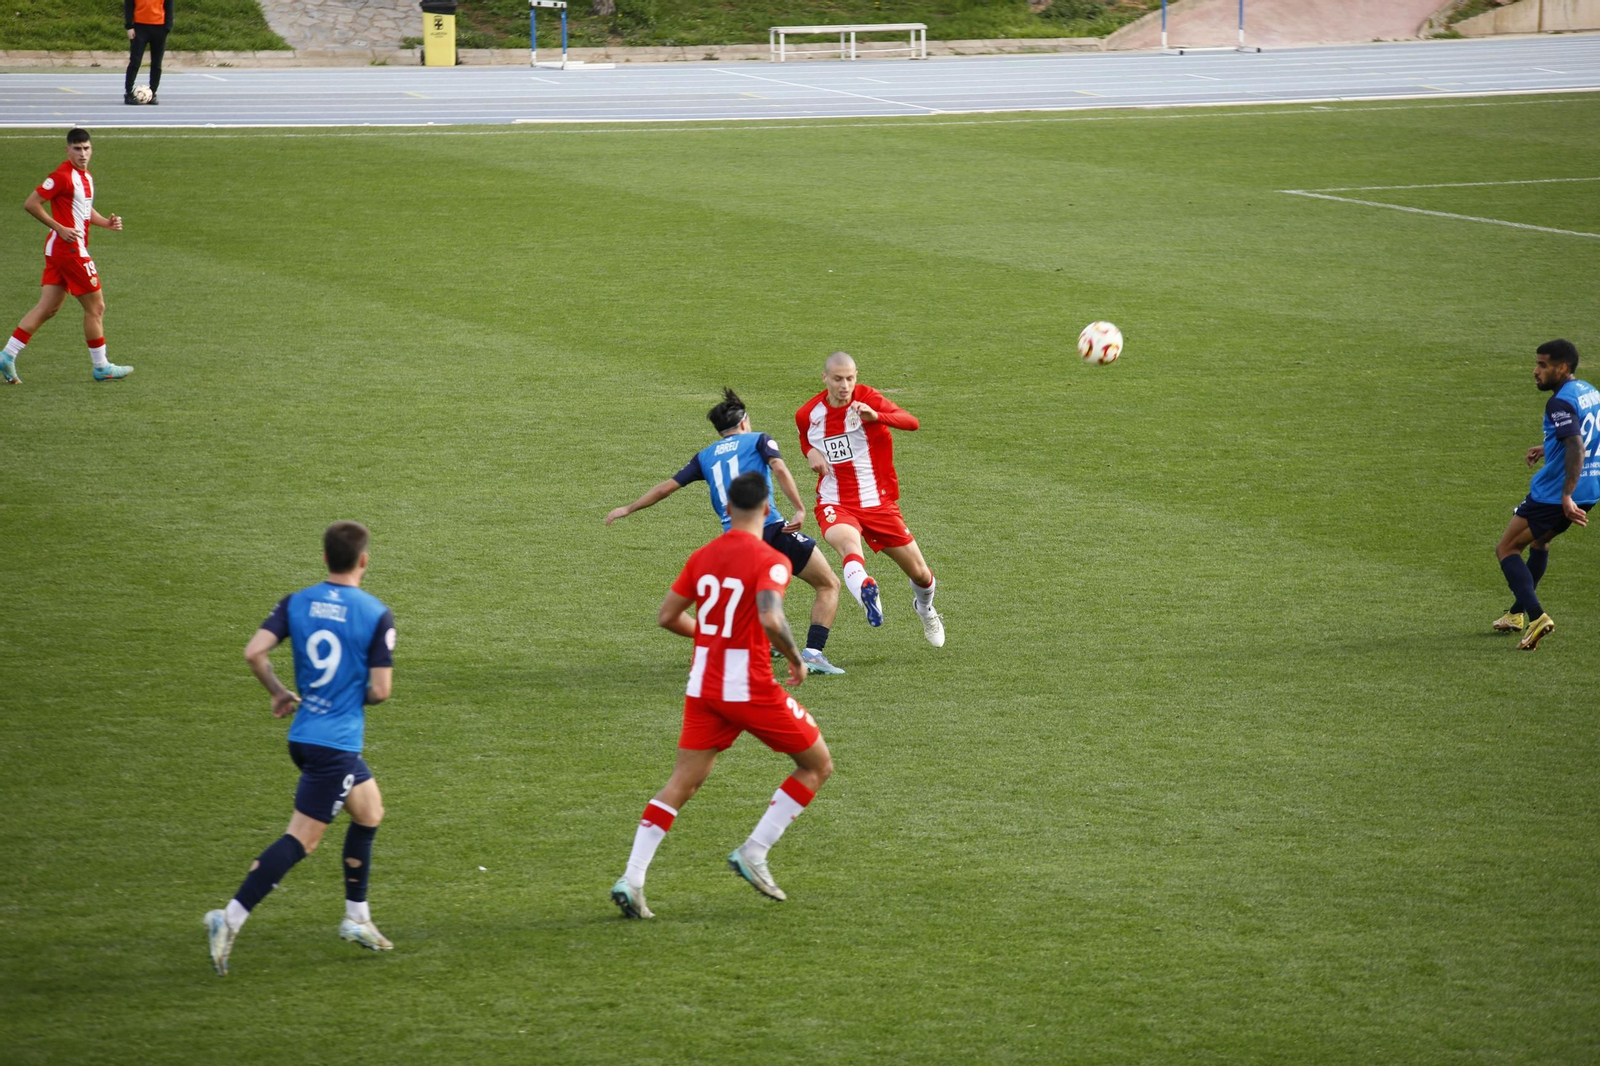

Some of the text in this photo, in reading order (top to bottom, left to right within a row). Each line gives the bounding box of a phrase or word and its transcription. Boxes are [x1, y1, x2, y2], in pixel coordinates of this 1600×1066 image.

[83, 260, 98, 277] 19
[714, 440, 739, 456] ABREU
[711, 454, 739, 507] 11
[697, 574, 745, 638] 27
[306, 629, 342, 688] 9
[339, 773, 355, 797] 9
